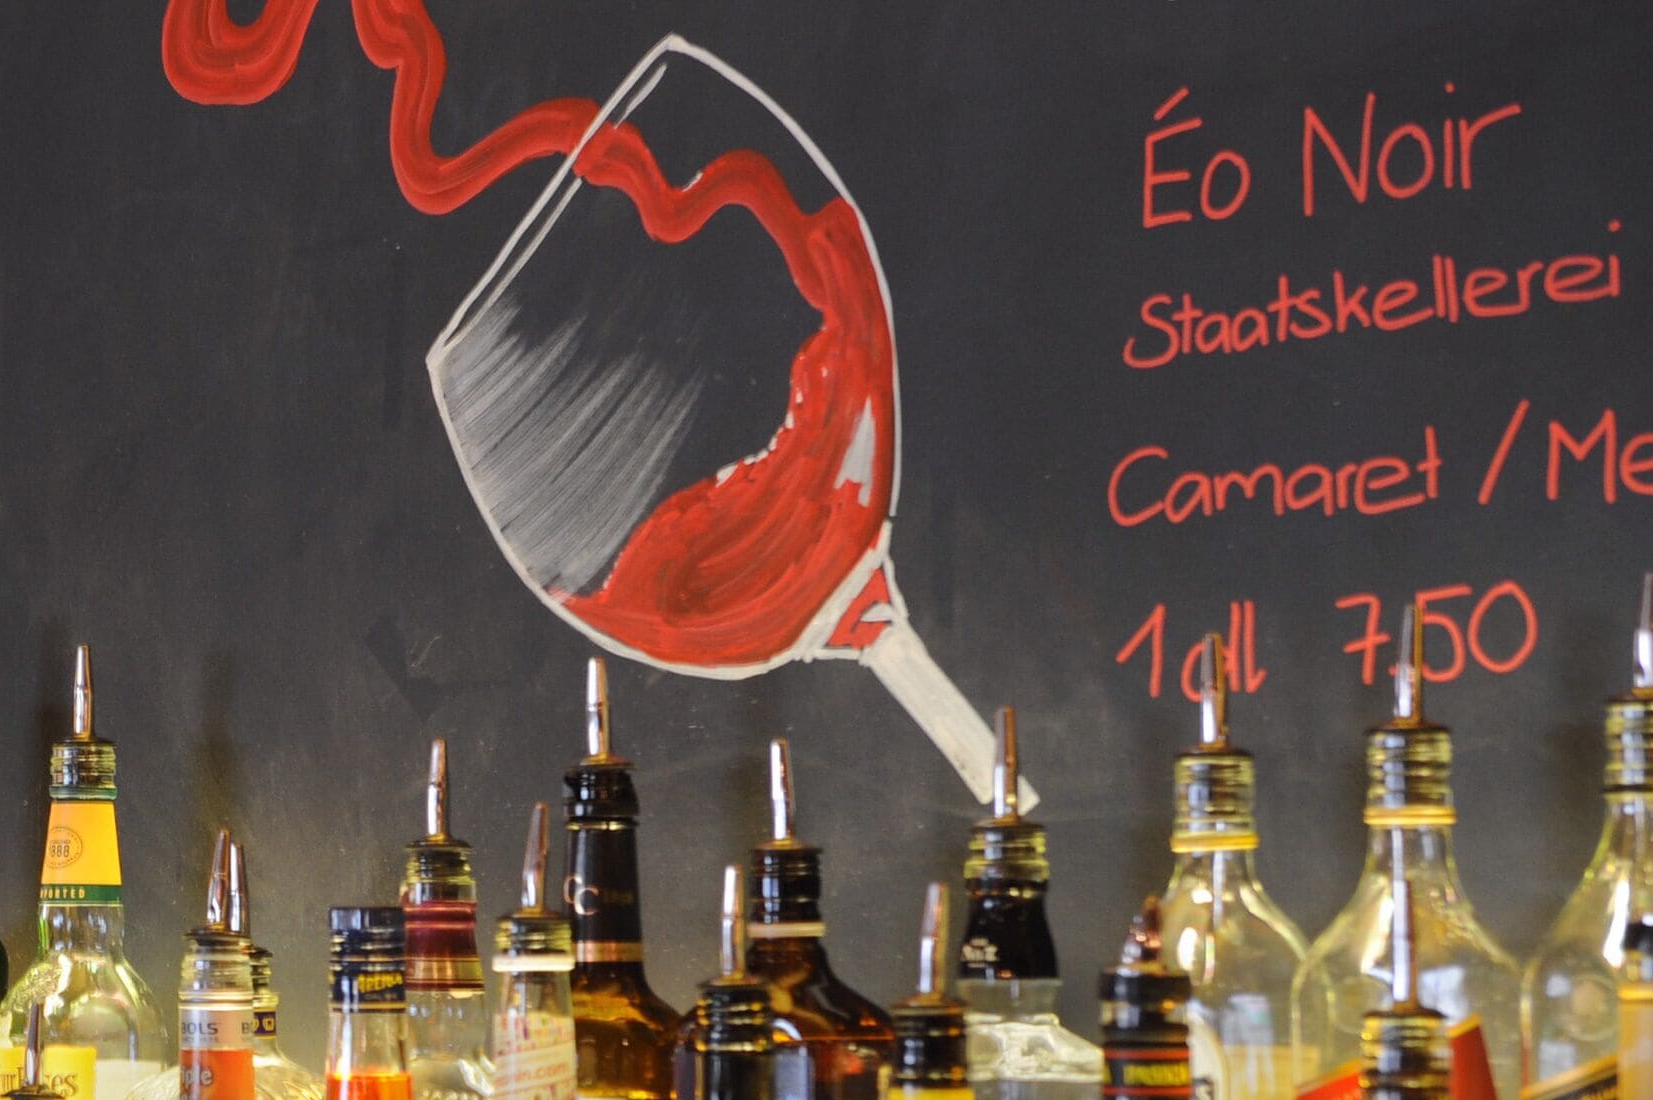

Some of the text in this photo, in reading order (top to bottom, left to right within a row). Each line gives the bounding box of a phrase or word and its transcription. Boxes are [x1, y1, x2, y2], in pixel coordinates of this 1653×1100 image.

[1143, 82, 1523, 229] Éo Noir
[1122, 218, 1623, 368] Staatskellerei
[1108, 425, 1443, 528] Camaret
[40, 886, 86, 899] PORTED
